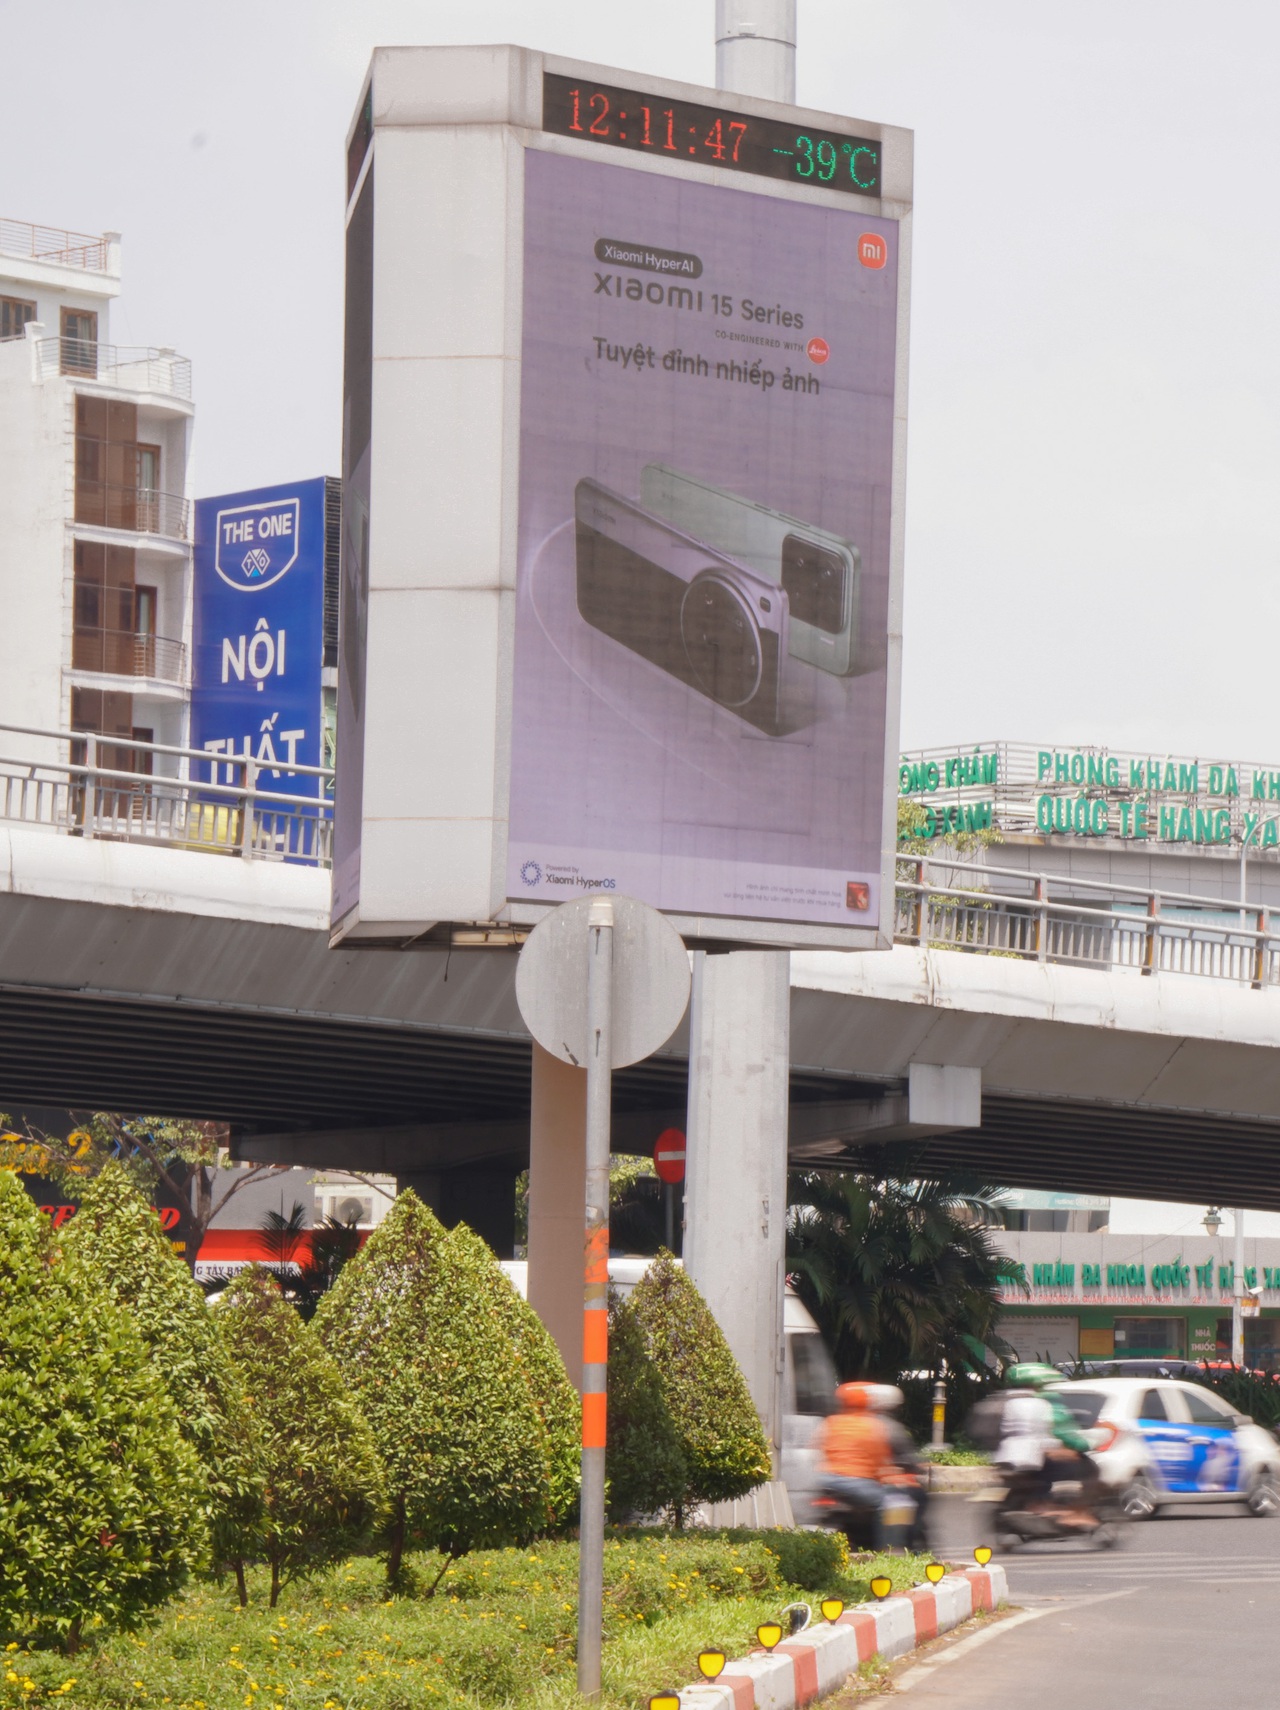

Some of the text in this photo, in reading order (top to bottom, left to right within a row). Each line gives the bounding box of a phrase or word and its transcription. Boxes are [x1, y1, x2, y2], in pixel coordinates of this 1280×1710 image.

[569, 88, 747, 162] 12:11:47
[604, 245, 694, 273] Xiaomi HyperAI
[711, 294, 732, 317] 15
[741, 299, 804, 330] Series
[715, 329, 804, 352] CO-ENGINEERED WITH
[592, 336, 820, 395] Tuyệt đỉnh nhiếp ảnh
[223, 513, 293, 544] THE ONE
[221, 617, 286, 692] NỘI
[204, 712, 305, 786] THẤT
[945, 746, 997, 788] KHÁM
[1037, 746, 1119, 787] PHÒNG
[1128, 754, 1198, 793] KHÁM
[1035, 787, 1108, 835] QUỐC
[1118, 791, 1149, 839] TẾ
[1156, 801, 1231, 844] HÀNG
[545, 874, 616, 889] Xiaomi HyperOS
[1033, 1256, 1075, 1286] KHÁM
[1082, 1263, 1102, 1286] ĐA
[1107, 1263, 1146, 1286] KHOA
[1152, 1254, 1190, 1290] QUỐC
[1195, 1256, 1214, 1288] TẾ
